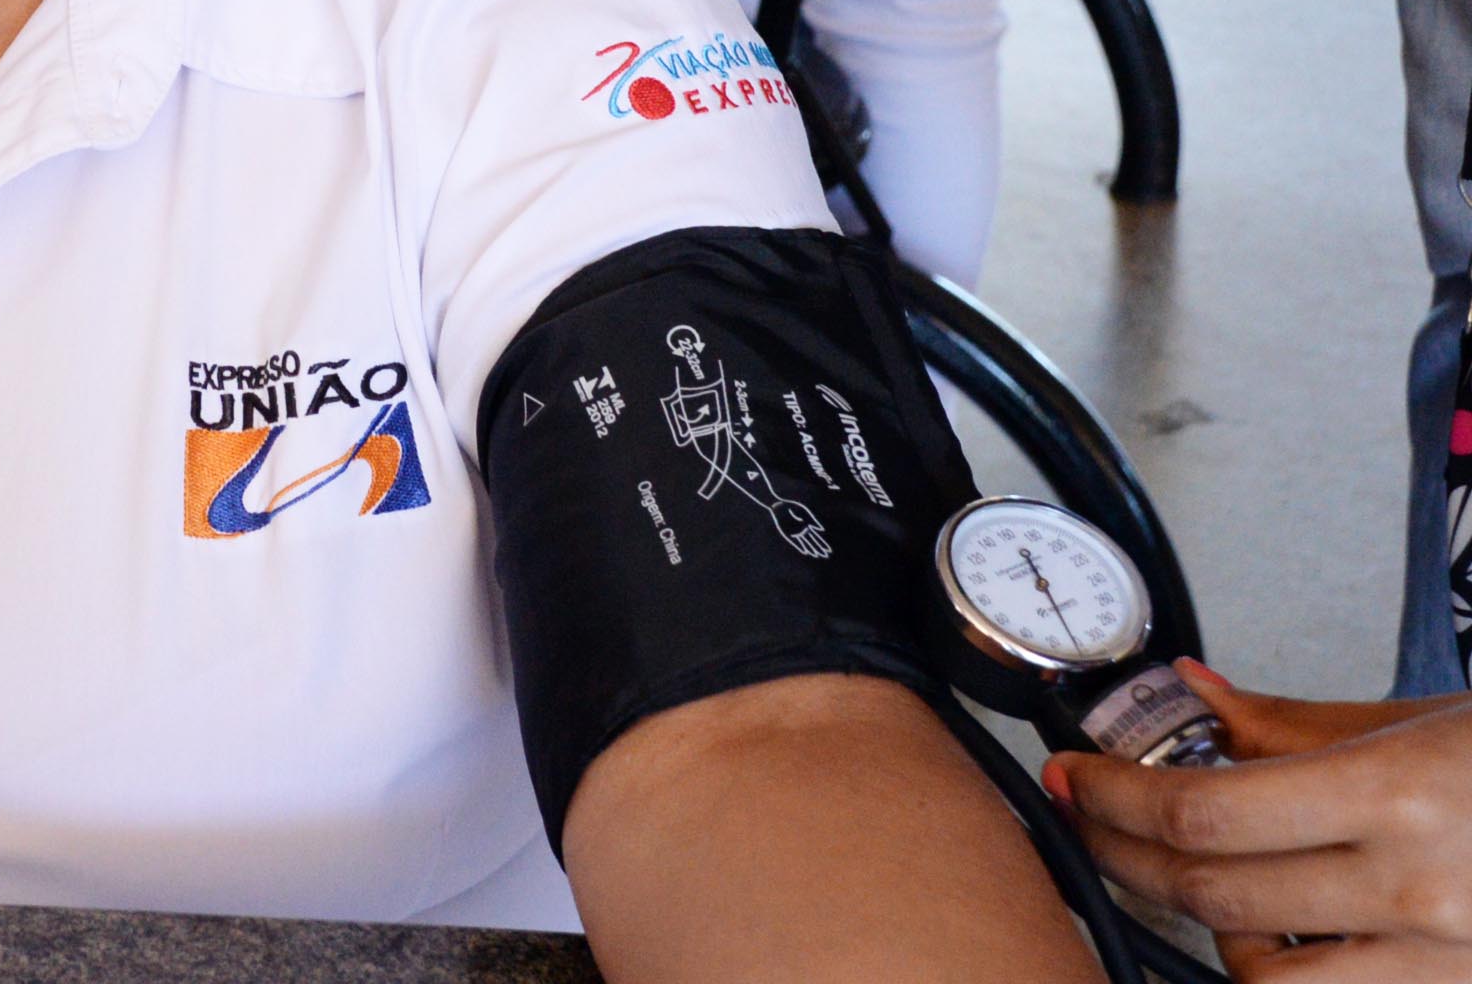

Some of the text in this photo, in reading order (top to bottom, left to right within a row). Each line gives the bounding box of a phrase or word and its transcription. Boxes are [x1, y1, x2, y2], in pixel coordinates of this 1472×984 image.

[655, 32, 748, 78] VIAÇÃO
[684, 79, 796, 115] EXPRE
[189, 358, 408, 431] UNIÃO
[783, 390, 807, 428] TIPO:
[586, 403, 608, 438] 2012
[659, 527, 682, 565] China
